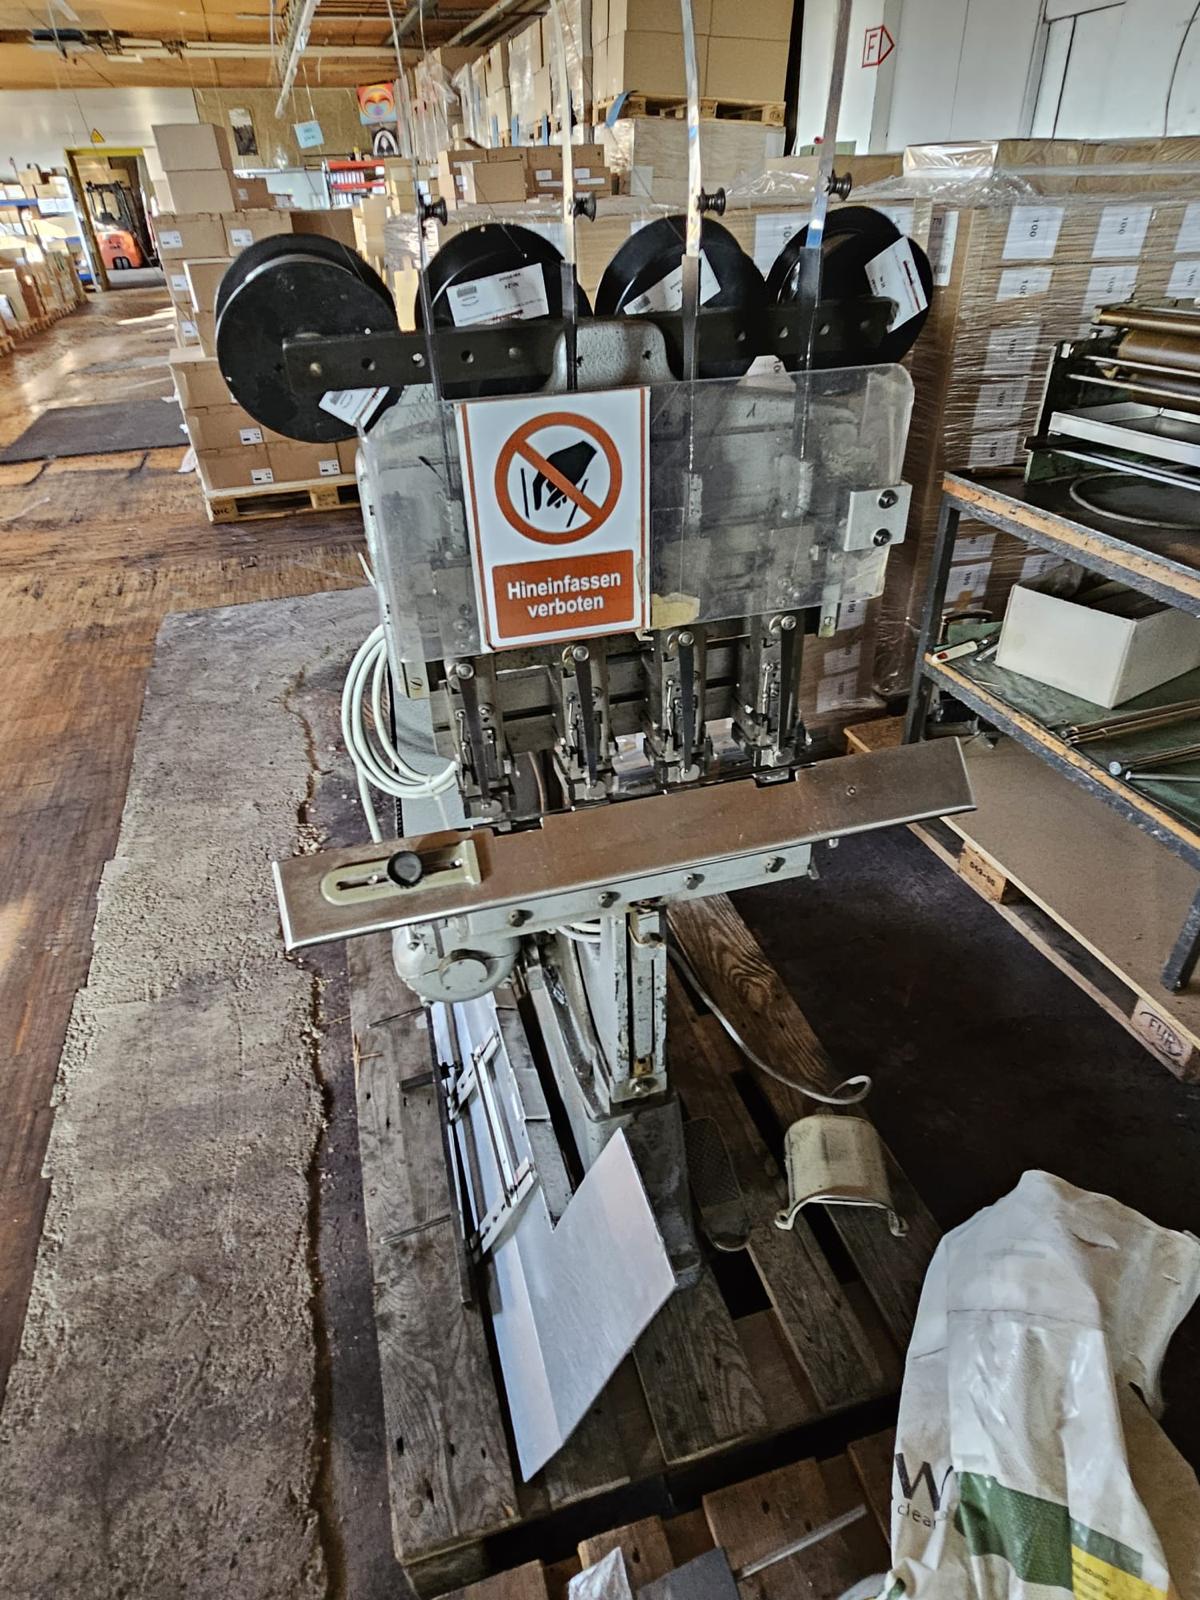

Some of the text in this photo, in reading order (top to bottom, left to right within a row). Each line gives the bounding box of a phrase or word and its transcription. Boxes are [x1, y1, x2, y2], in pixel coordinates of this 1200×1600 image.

[867, 33, 878, 60] F
[1030, 217, 1039, 237] 100
[1118, 217, 1128, 235] 100
[507, 572, 621, 600] Hineinfassen
[527, 595, 604, 618] verboten
